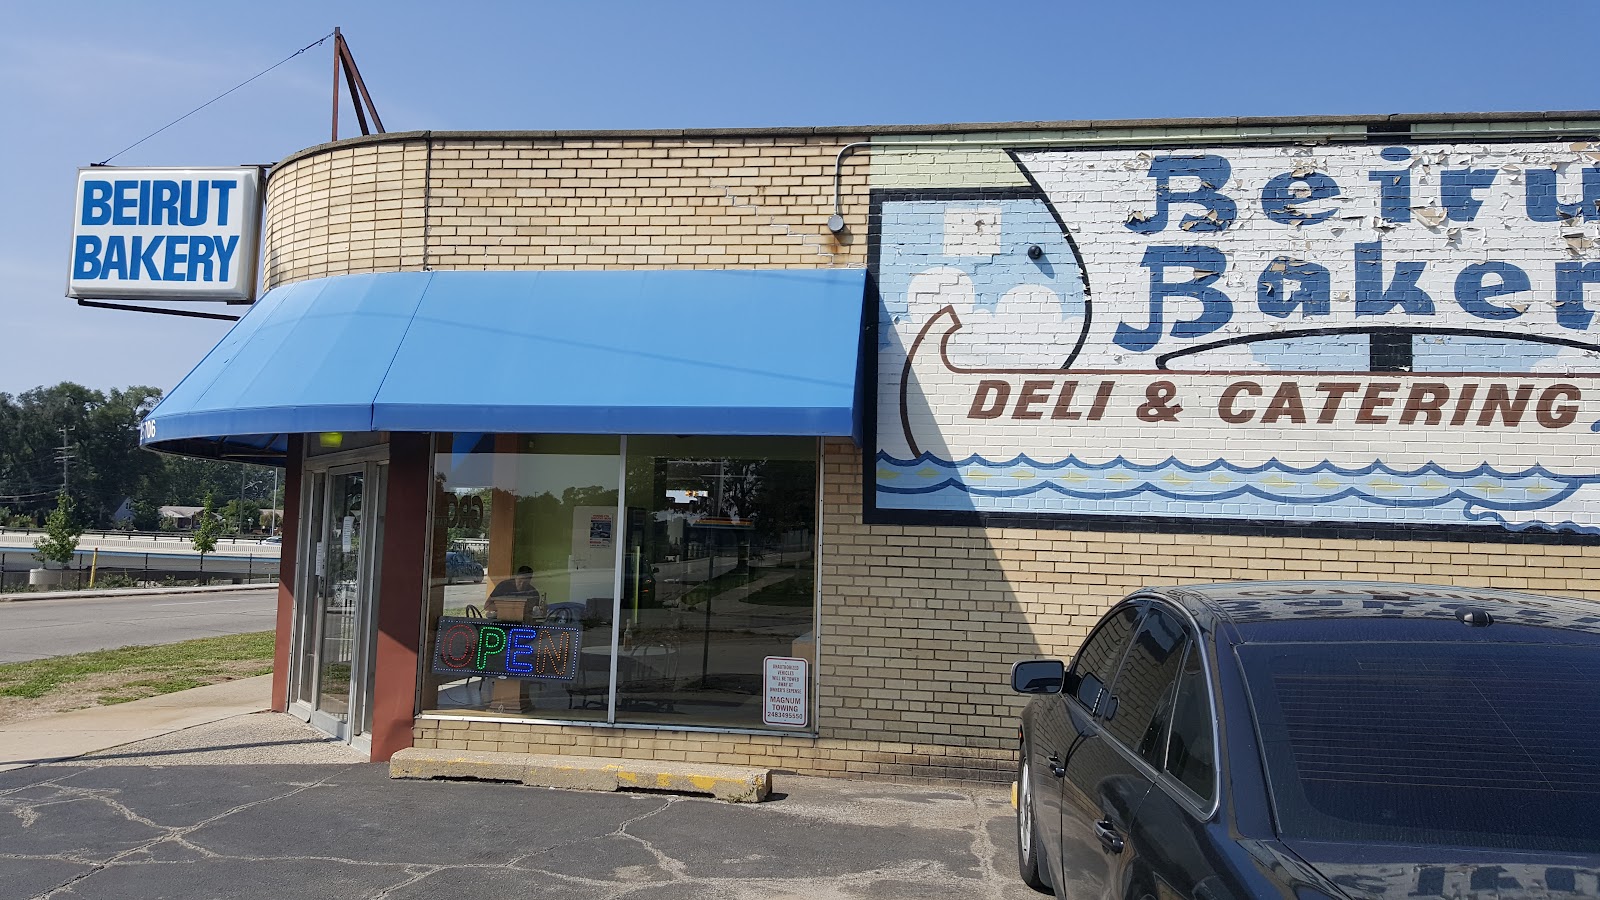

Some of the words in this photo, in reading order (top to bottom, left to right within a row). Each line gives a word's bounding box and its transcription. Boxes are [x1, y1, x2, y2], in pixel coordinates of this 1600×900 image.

[81, 180, 237, 226] BEIRUT
[1124, 147, 1600, 234] Beiru
[73, 235, 240, 282] BAKERY
[1112, 241, 1600, 352] Baker
[967, 380, 1116, 421] DELI
[1136, 381, 1184, 423] &
[1218, 381, 1582, 429] CATERING
[442, 624, 570, 675] OPEN
[770, 696, 801, 705] MAGNUM
[772, 704, 798, 712] TOWING
